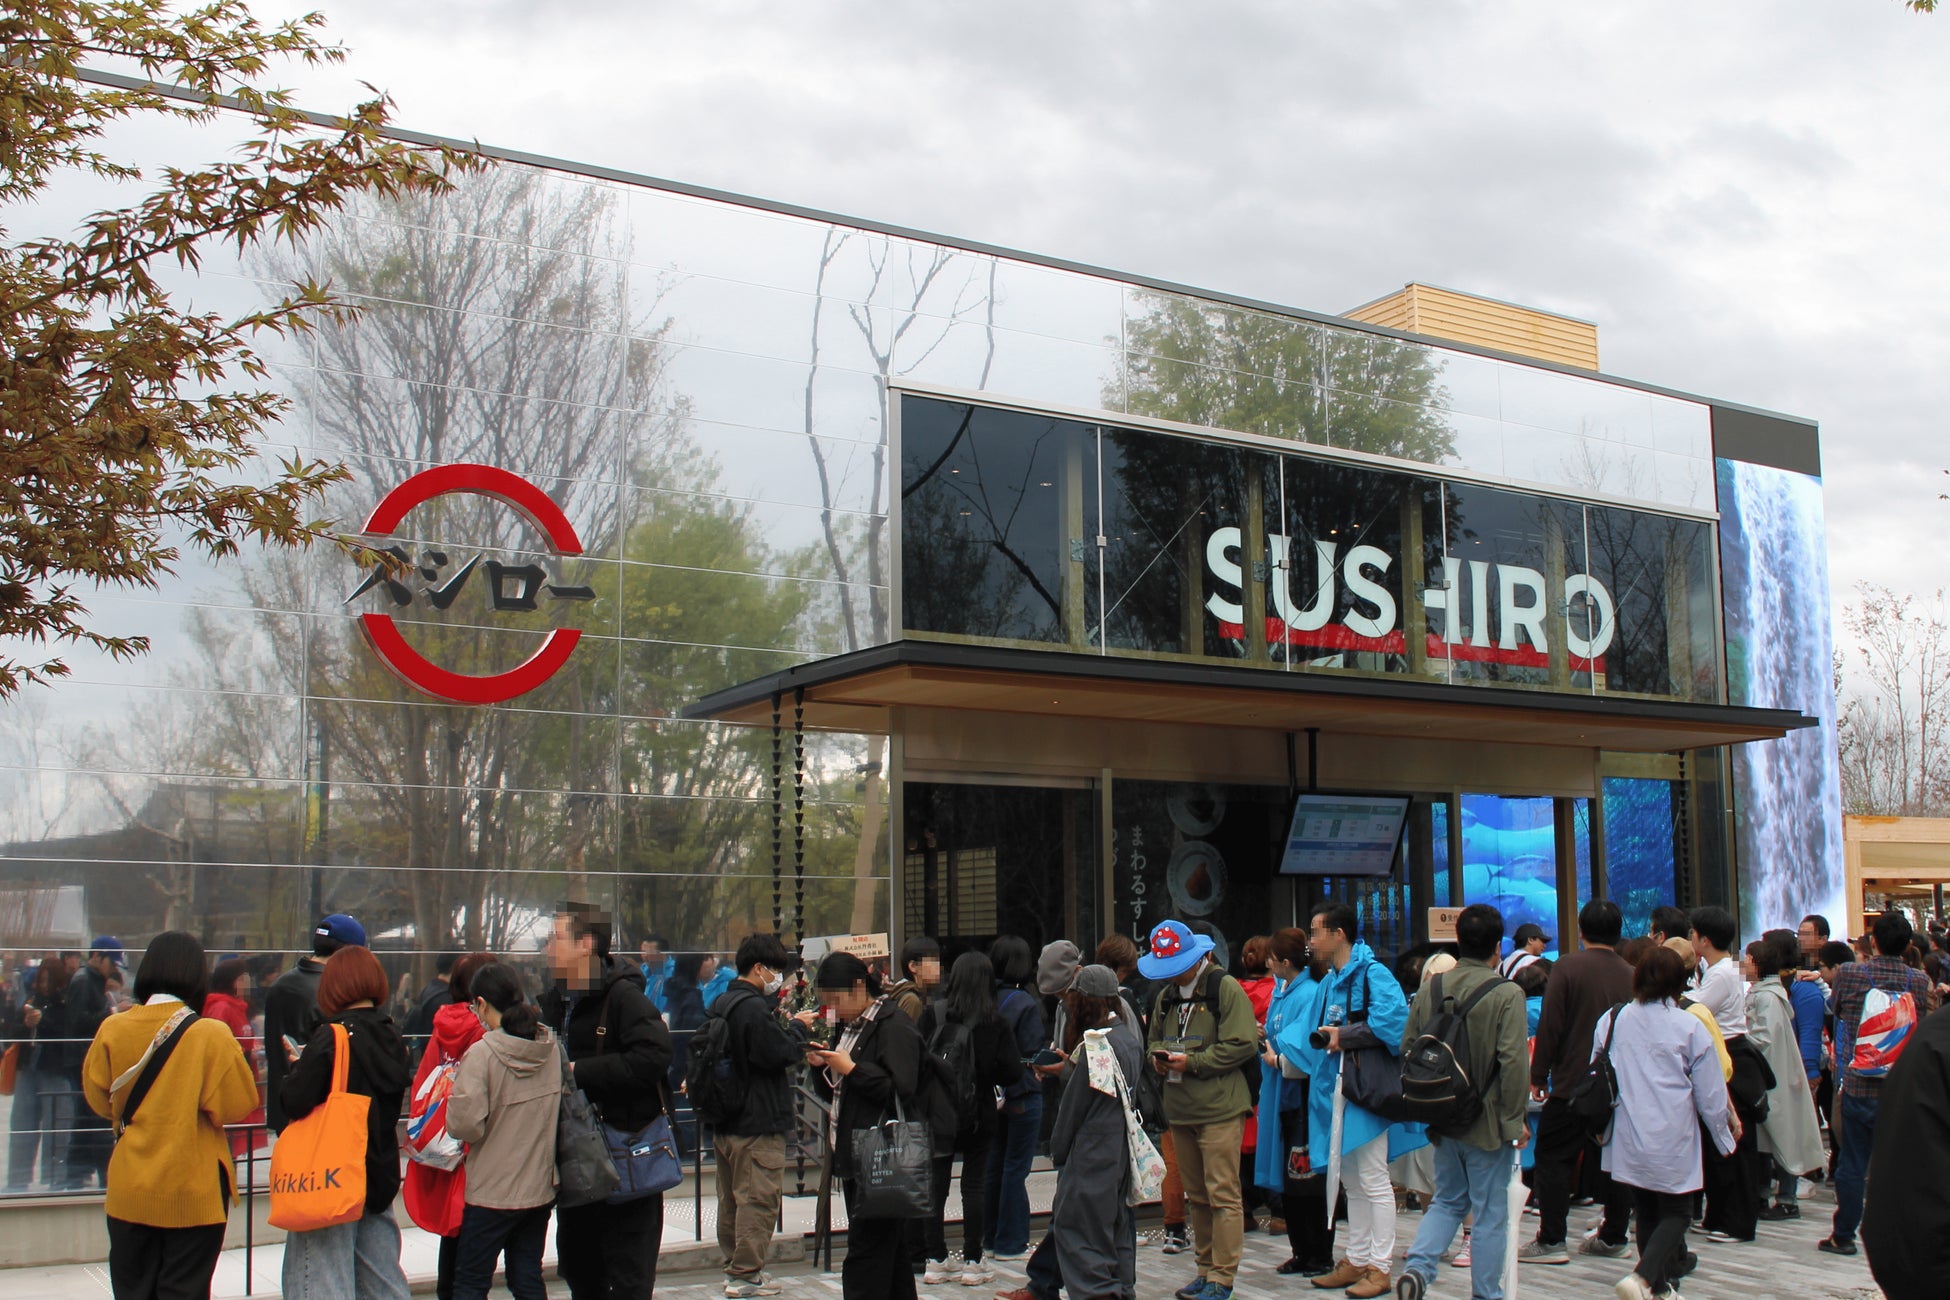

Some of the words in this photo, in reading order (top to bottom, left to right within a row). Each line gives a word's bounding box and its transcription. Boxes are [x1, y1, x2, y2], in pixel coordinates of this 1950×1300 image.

[343, 545, 597, 612] スシロー
[1205, 526, 1616, 660] SUSHIRO
[272, 1167, 341, 1194] kikki.K
